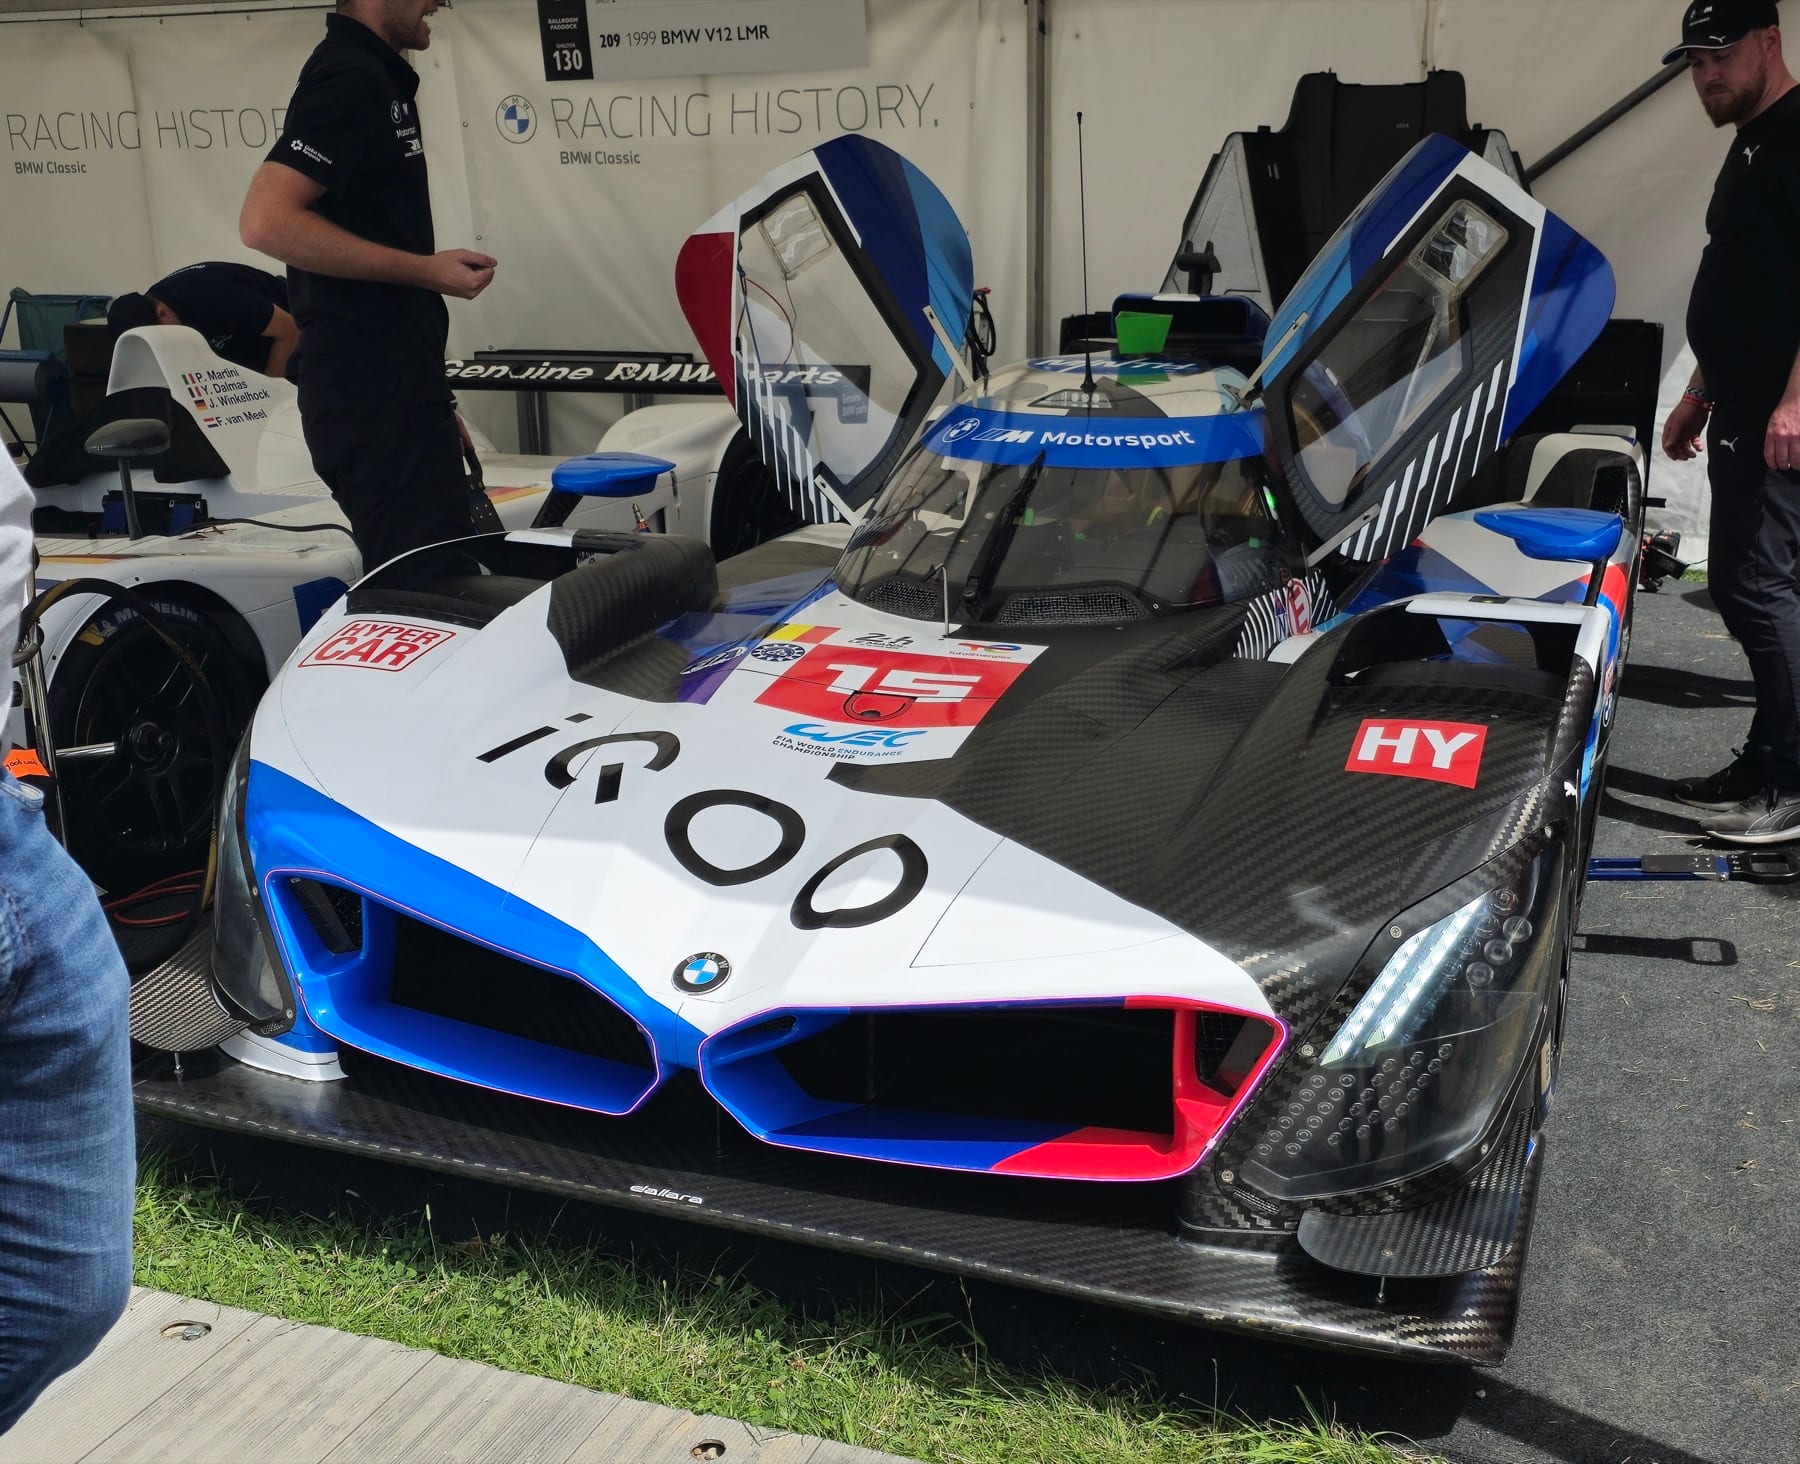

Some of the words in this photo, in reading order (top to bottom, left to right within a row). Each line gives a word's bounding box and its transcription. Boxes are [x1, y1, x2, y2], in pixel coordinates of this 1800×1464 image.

[548, 17, 579, 25] BALLROOM
[599, 34, 621, 48] 209
[626, 31, 657, 47] 1999
[661, 28, 701, 45] BMW
[705, 27, 733, 42] V12
[737, 25, 770, 41] LMR
[552, 50, 583, 71] 130
[550, 93, 711, 140] RACING
[730, 82, 939, 136] HISTORY.
[6, 111, 141, 151] RACING
[15, 162, 44, 174] BMW
[46, 161, 87, 174] Classic
[560, 151, 592, 164] BMW
[594, 150, 641, 164] Classic
[195, 371, 207, 383] P.
[207, 367, 240, 381] Martini
[200, 385, 213, 396] Y.
[213, 380, 248, 394] Dalmas
[208, 397, 218, 409] J.
[217, 388, 270, 407] Winkelhock
[226, 414, 242, 425] van
[242, 408, 268, 422] Meel
[1039, 430, 1196, 450] Motorsport
[340, 623, 441, 645] HYPER
[314, 636, 420, 667] CAR
[825, 663, 983, 703] 15
[775, 735, 793, 744] FIA
[797, 741, 836, 752] WORLD
[837, 748, 904, 757] ENDURANCE
[783, 723, 929, 748] WEC
[772, 740, 856, 760] CHAMPIONSHIP
[1356, 726, 1479, 770] HY
[629, 1185, 703, 1204] dallara
